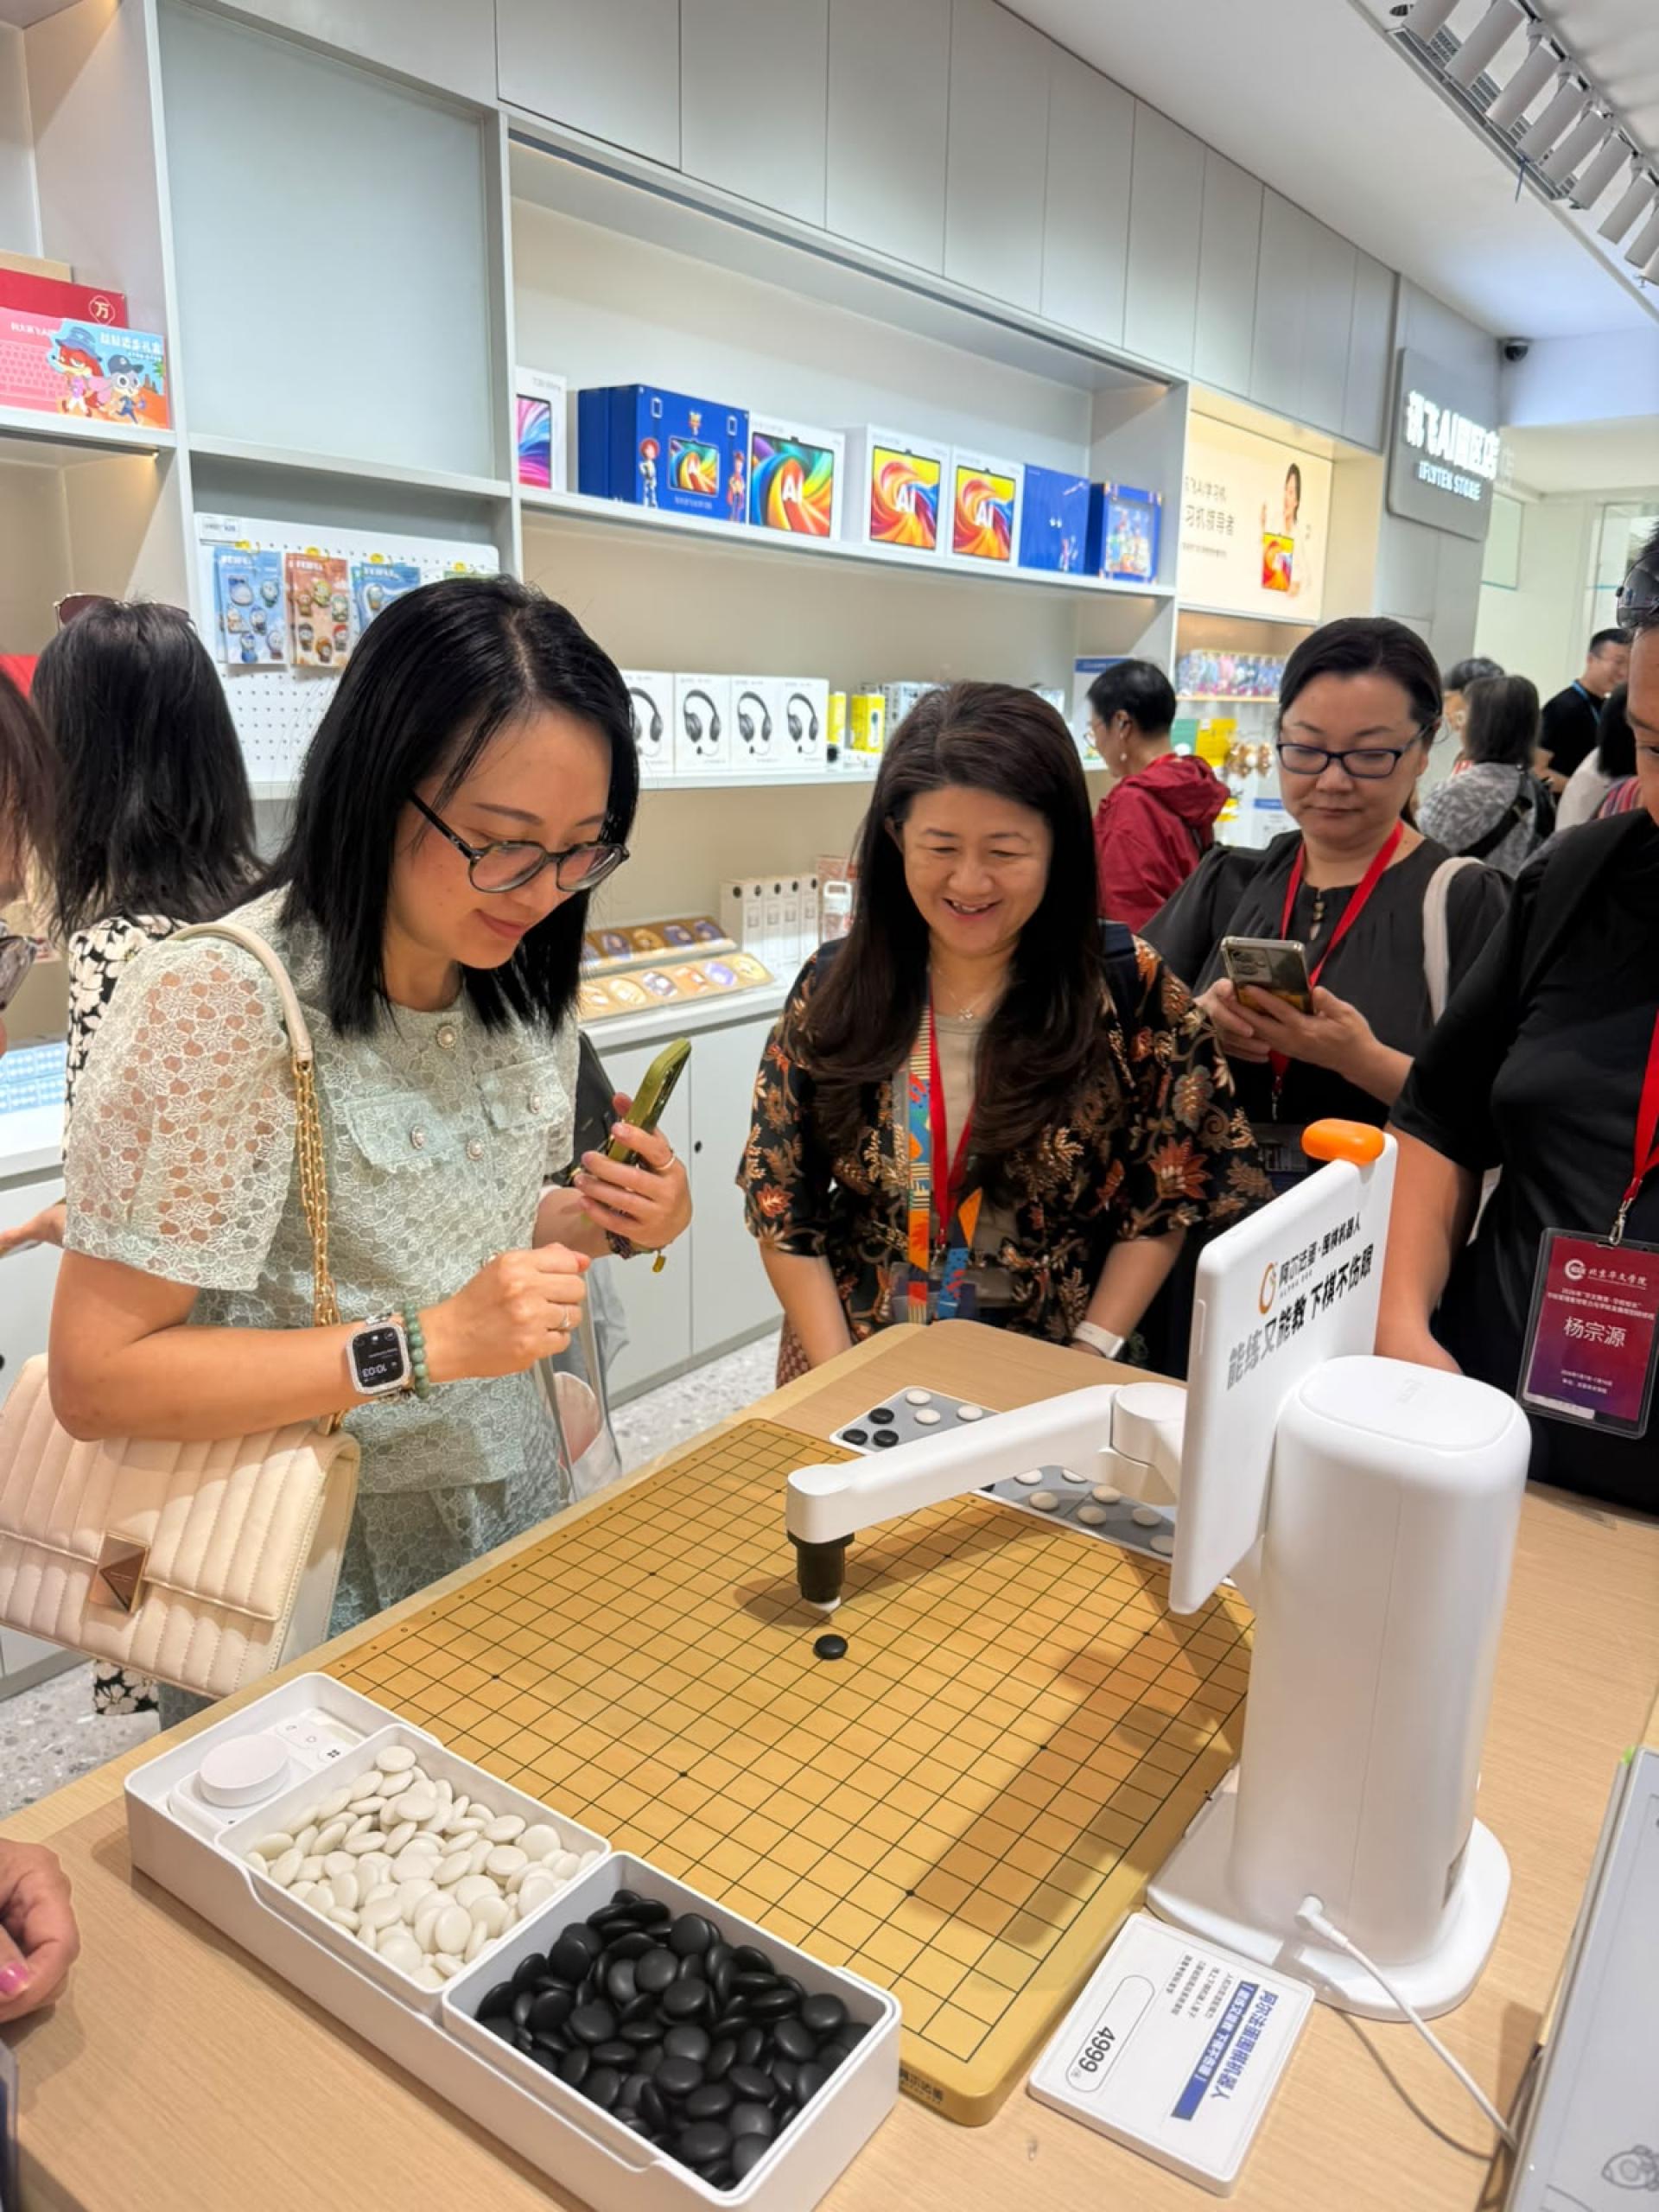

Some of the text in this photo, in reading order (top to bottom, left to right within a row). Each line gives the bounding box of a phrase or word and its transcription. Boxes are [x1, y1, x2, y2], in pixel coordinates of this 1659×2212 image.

[94, 301, 111, 319] 万
[782, 472, 803, 505] AI
[895, 484, 916, 513] AI
[975, 500, 995, 529] AI
[1228, 1243, 1373, 1389] 能练又能教 下棋不伤眼
[1563, 1316, 1627, 1348] 杨宗源
[1078, 2026, 1116, 2072] 4999
